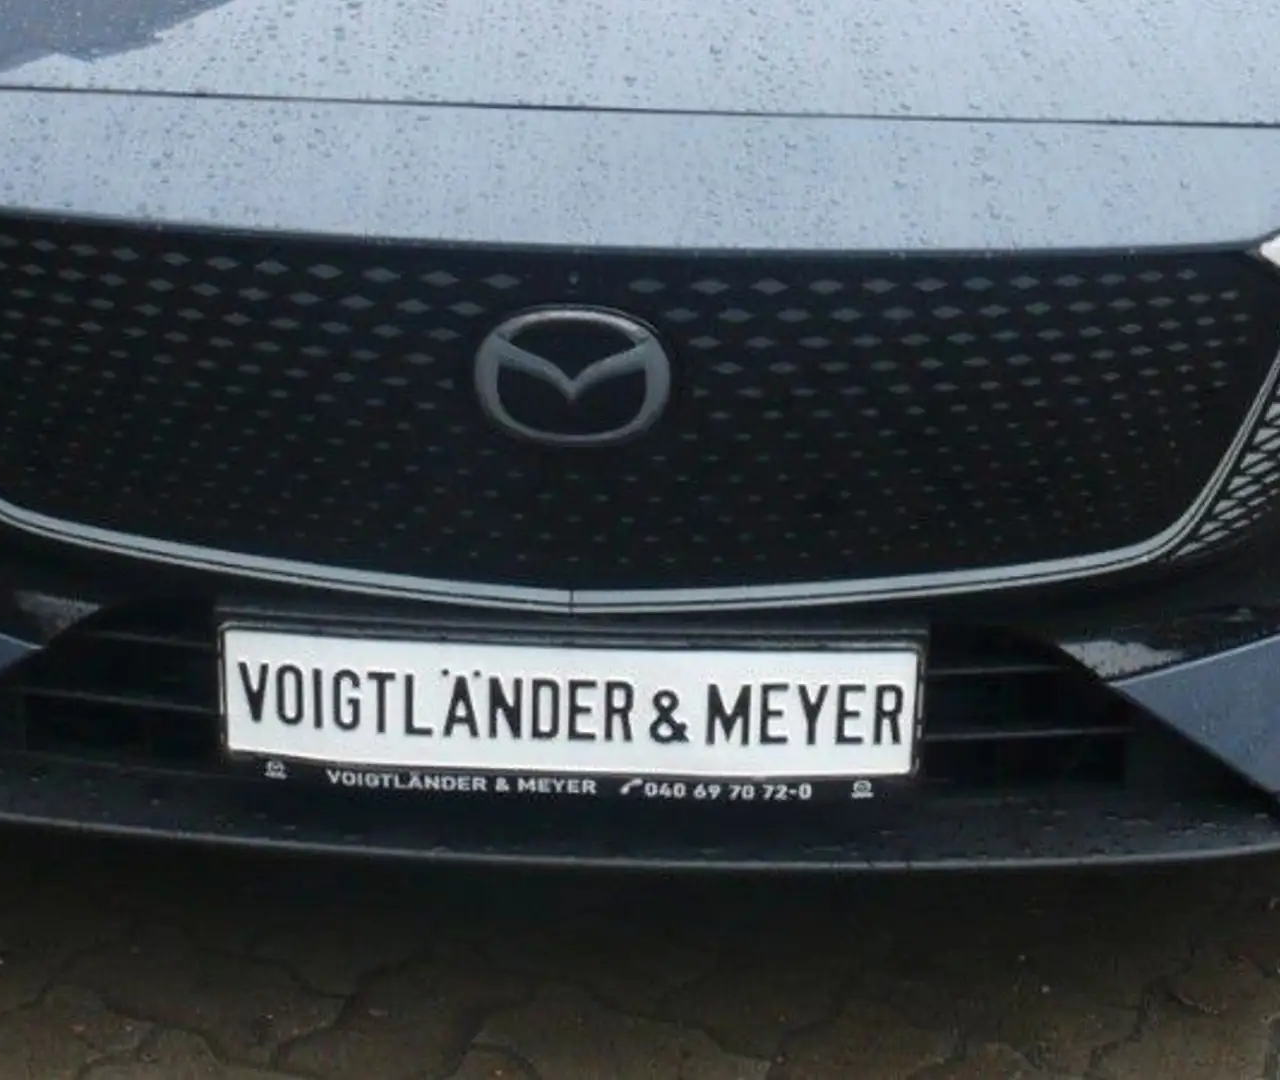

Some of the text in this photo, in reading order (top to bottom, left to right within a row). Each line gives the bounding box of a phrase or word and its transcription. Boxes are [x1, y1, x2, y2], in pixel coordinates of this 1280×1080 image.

[237, 661, 907, 747] VOIGTLÄNDER & MEYER
[325, 767, 813, 801] VOIGTLÄNDER & MEYER 040 69 70 72-0
